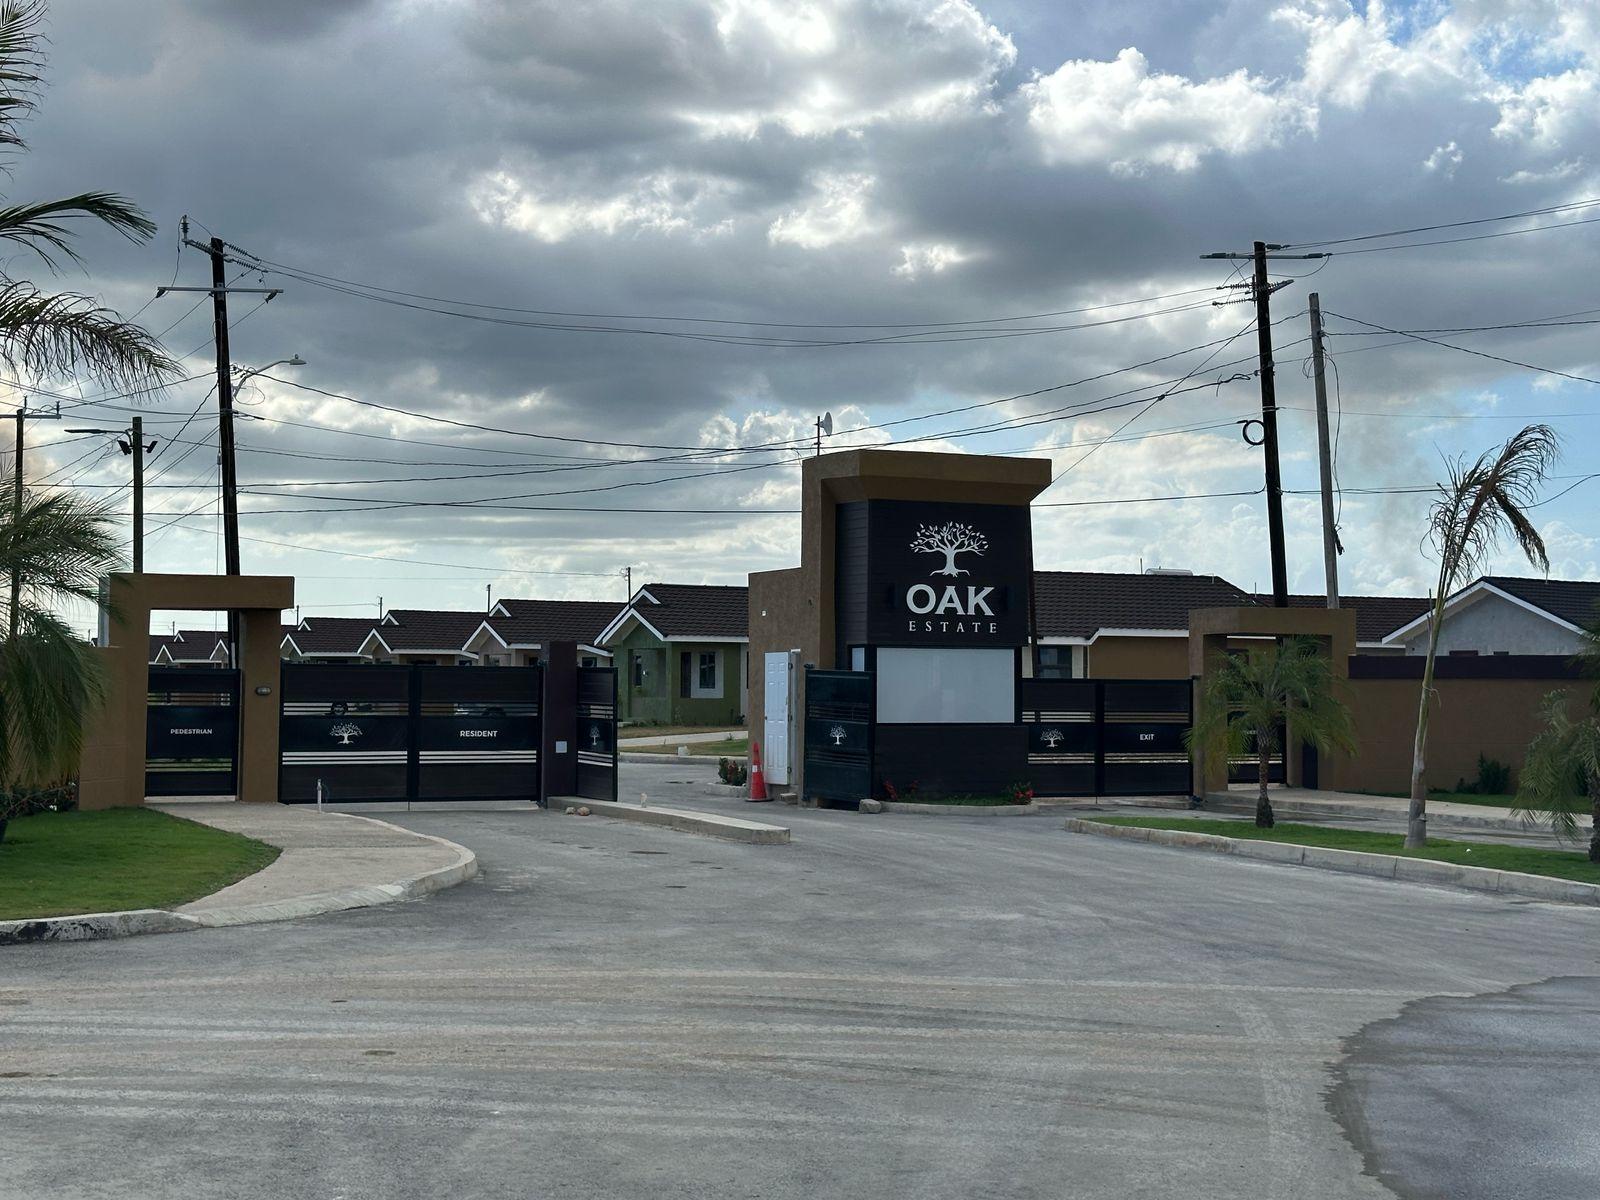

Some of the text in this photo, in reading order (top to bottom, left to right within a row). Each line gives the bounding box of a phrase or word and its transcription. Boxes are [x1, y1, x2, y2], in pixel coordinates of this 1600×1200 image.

[906, 583, 995, 616] OAK
[908, 620, 997, 634] ESTATE
[459, 729, 498, 738] RESIDENT
[1139, 733, 1155, 741] EXIT
